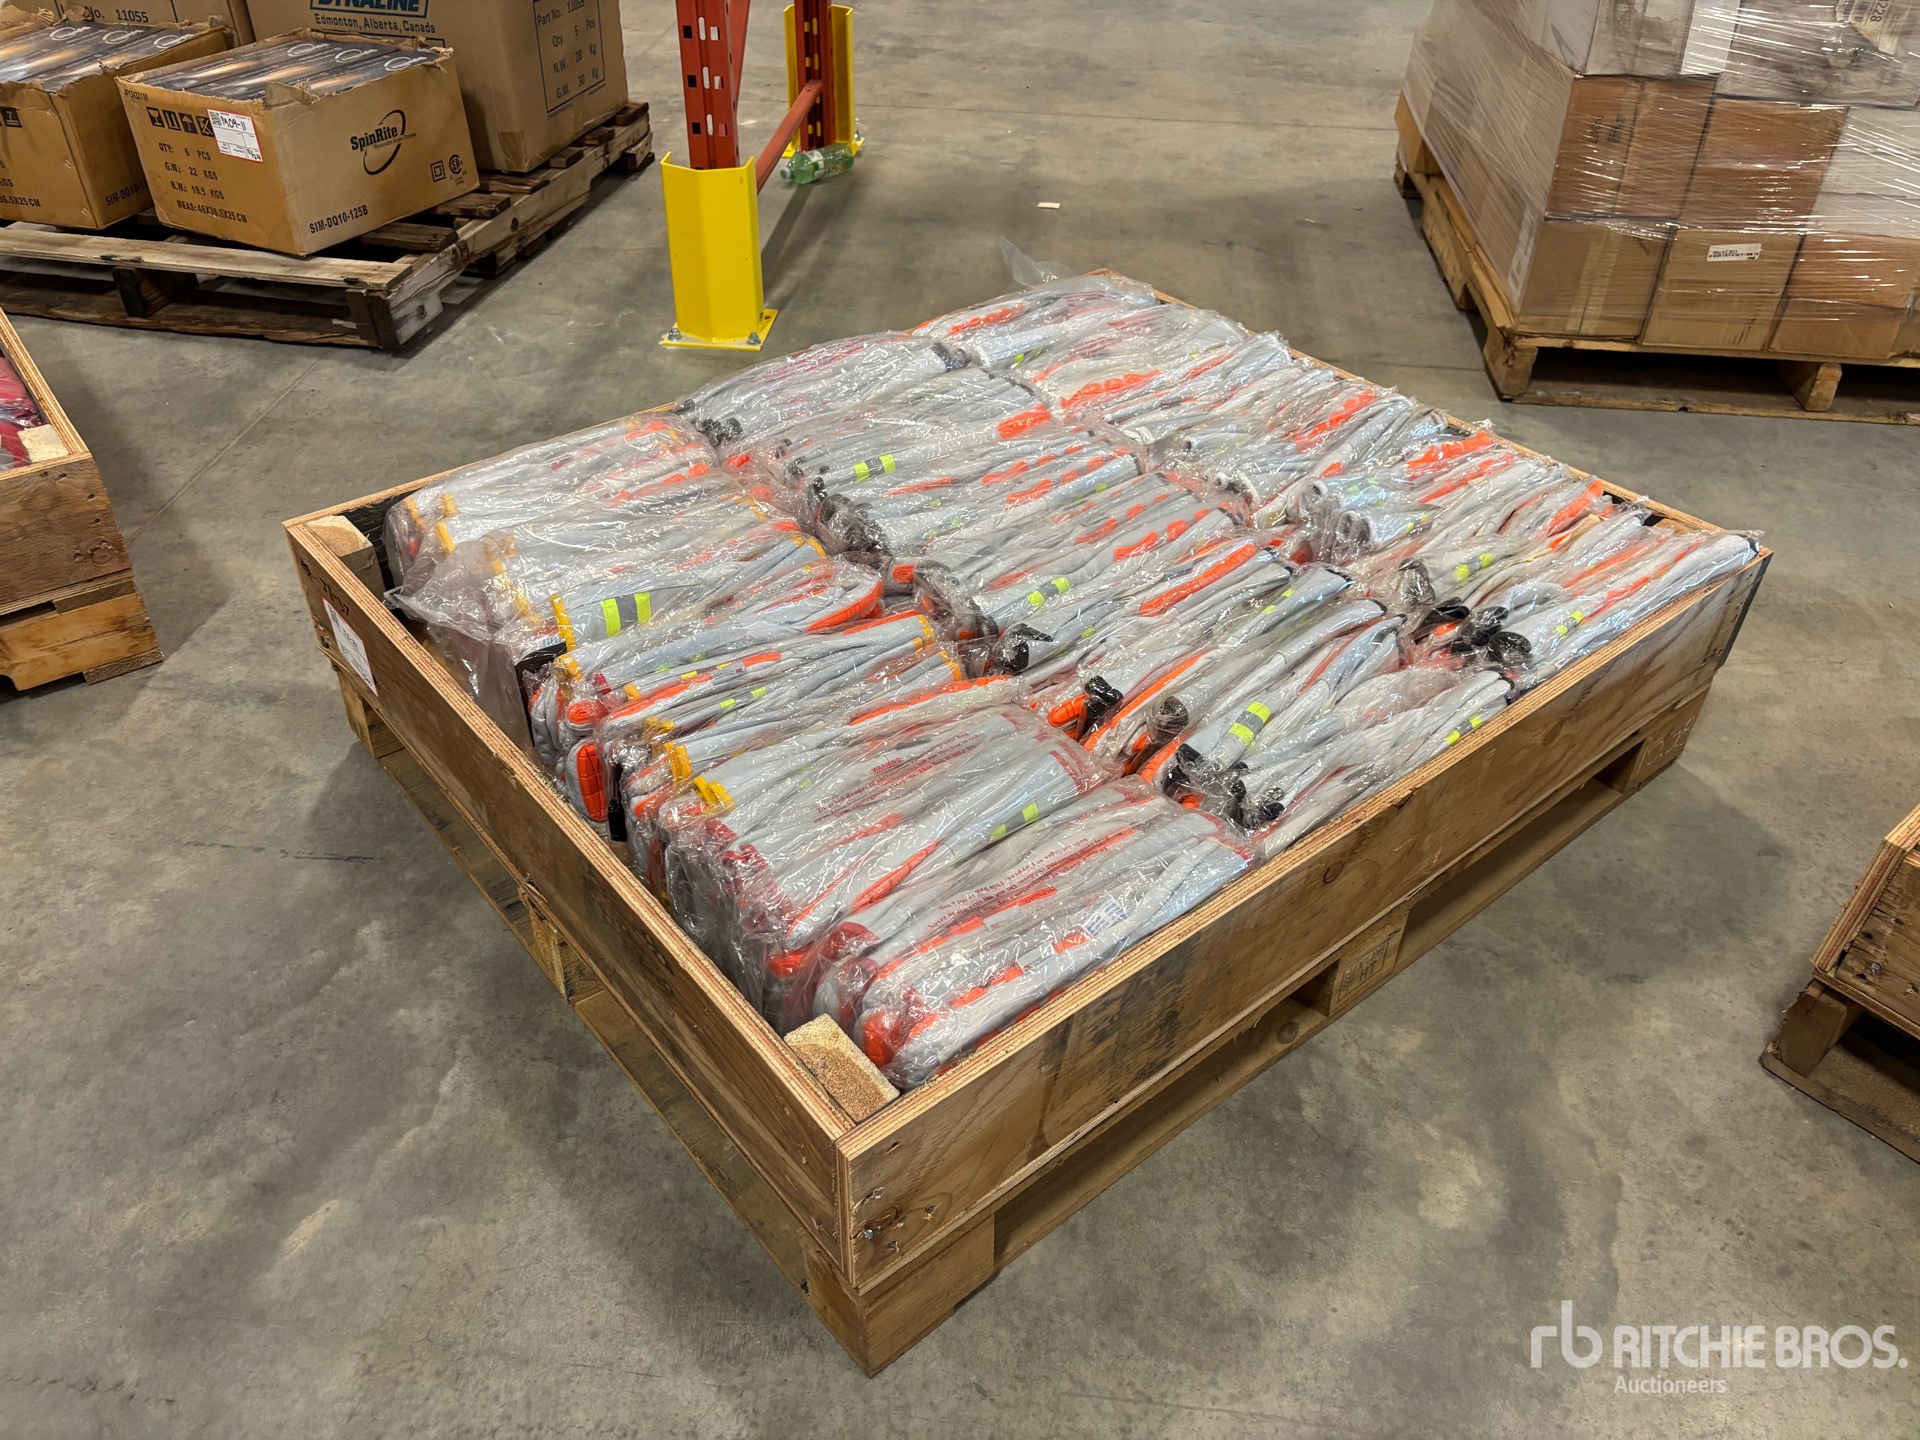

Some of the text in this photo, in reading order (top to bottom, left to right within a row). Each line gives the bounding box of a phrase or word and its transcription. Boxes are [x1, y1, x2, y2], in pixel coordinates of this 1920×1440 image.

[115, 9, 149, 22] 11055
[314, 13, 436, 34] Edmonton, Alberta, Canada
[574, 25, 579, 36] 5
[350, 126, 398, 151] SpinRite
[185, 148, 190, 156] 6
[197, 150, 211, 161] PCS
[188, 167, 198, 176] 22
[203, 169, 218, 180] KGS
[192, 185, 206, 196] 19.5
[210, 189, 224, 200] KGS
[309, 204, 369, 234] SIM-DQ10-125B
[871, 755, 903, 774] WARNING:
